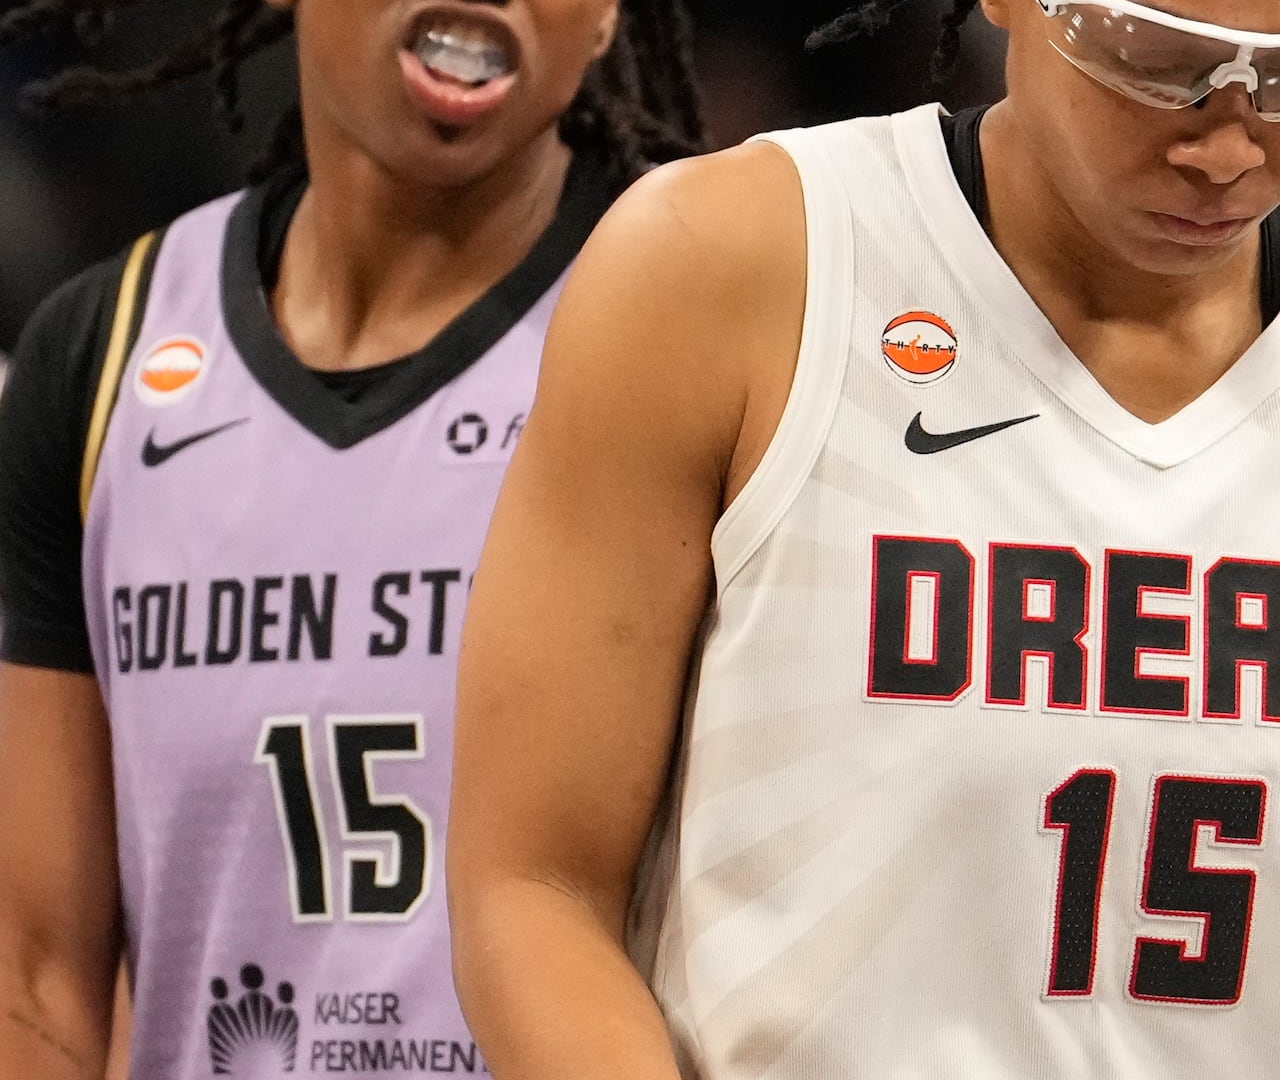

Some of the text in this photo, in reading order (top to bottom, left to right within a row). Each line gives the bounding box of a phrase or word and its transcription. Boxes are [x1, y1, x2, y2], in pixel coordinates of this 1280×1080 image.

[111, 572, 336, 674] GOLDEN
[257, 718, 432, 922] 15
[1042, 766, 1270, 1006] 15
[310, 1037, 489, 1073] PERMANEN
[313, 991, 402, 1025] KAISER
